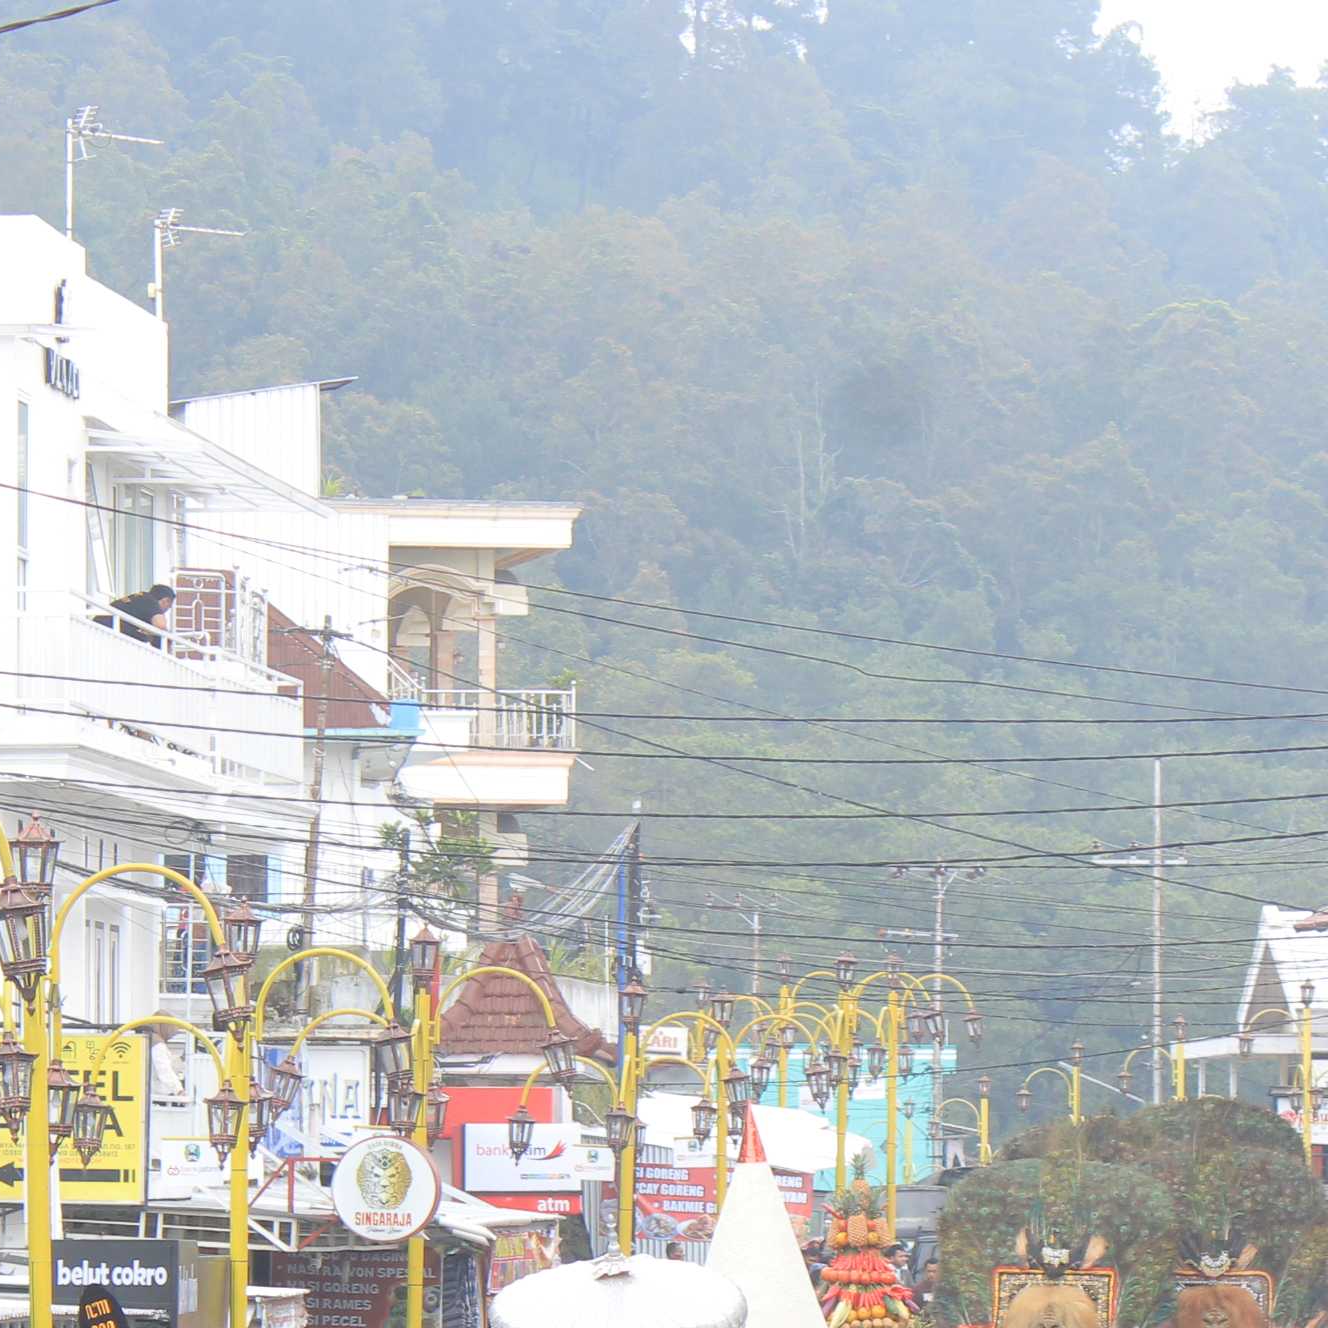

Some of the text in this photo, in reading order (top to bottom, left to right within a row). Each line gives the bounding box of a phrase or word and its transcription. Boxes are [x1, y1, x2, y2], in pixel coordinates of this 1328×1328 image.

[645, 1167, 689, 1182] GORENG
[660, 1183, 705, 1198] GORENG
[537, 1197, 571, 1212] atm
[663, 1200, 704, 1213] BAKMIE
[354, 1212, 413, 1228] SINGARAJA
[56, 1259, 168, 1287] belut cokro
[322, 1281, 380, 1295] GORENG
[320, 1300, 372, 1311] RAMES
[322, 1315, 367, 1328] PECEL
